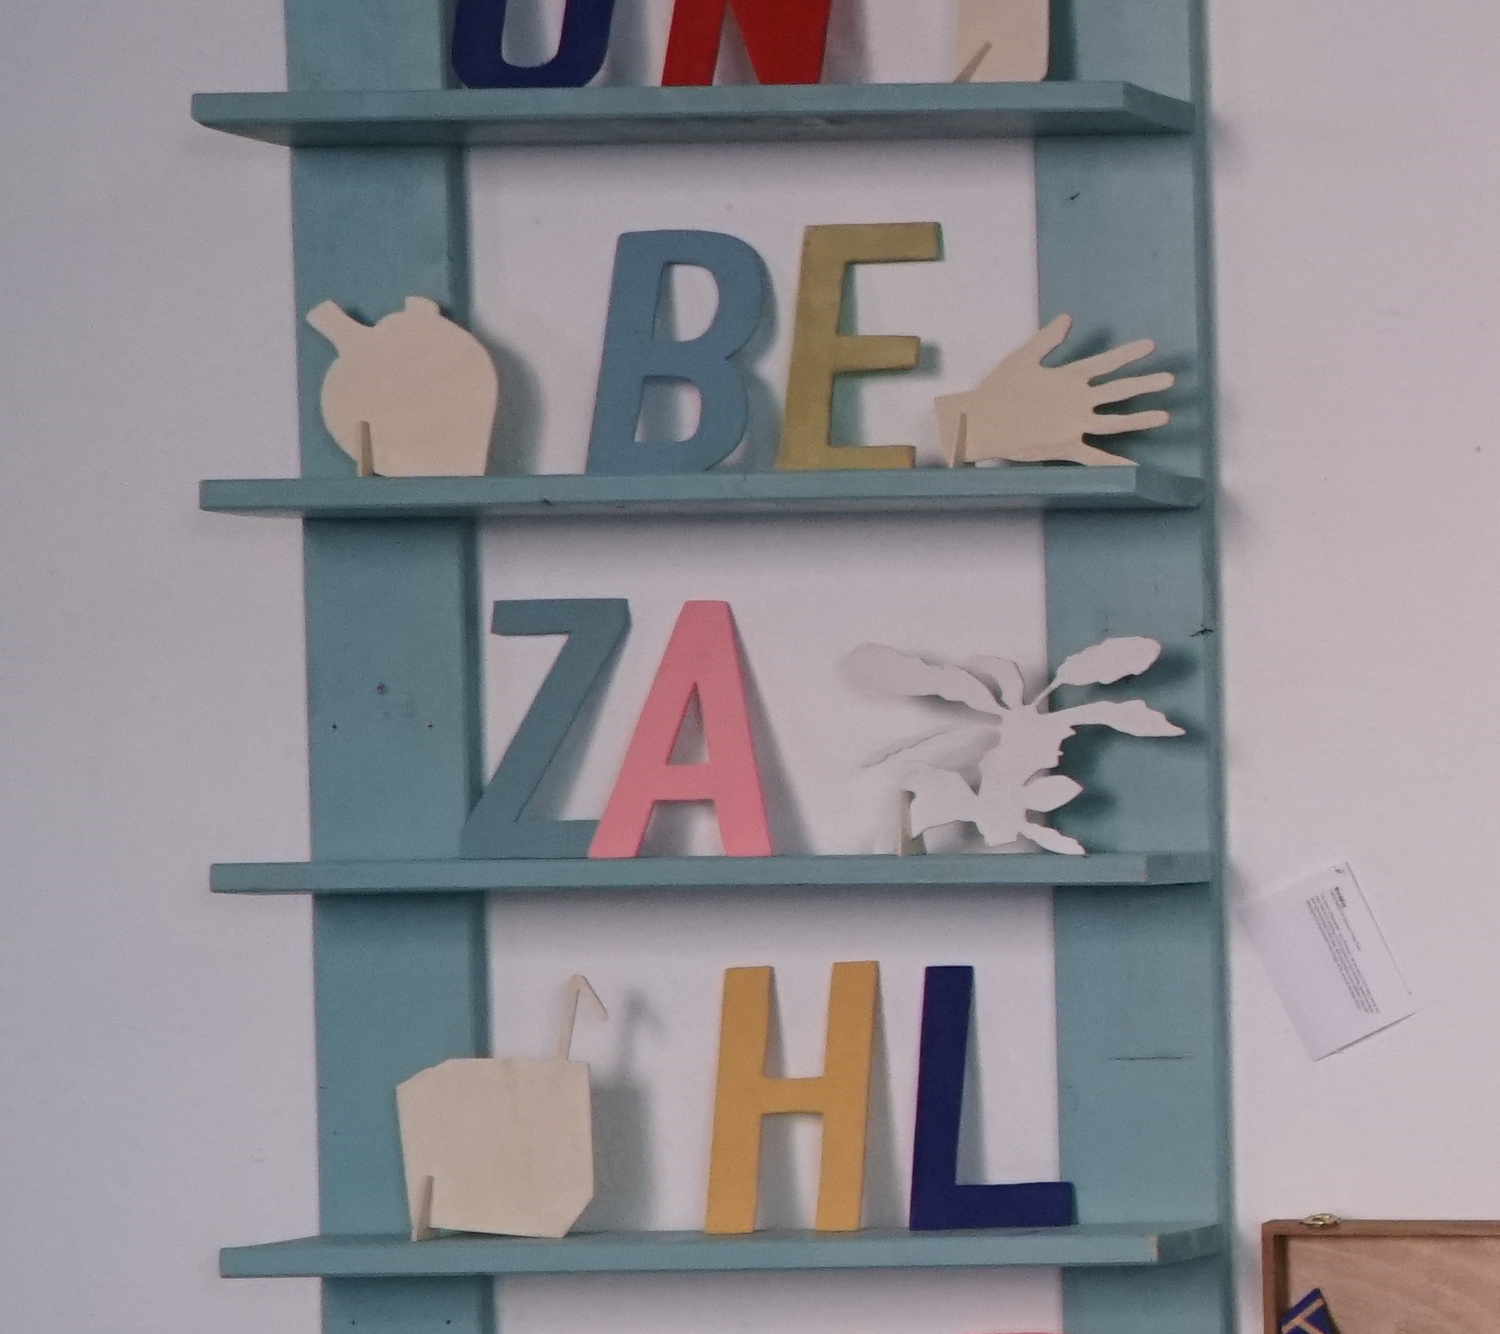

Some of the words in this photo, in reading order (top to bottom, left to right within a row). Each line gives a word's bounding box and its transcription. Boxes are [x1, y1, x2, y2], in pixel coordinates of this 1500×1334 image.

[586, 221, 943, 472] BE
[458, 597, 773, 860] ZA
[704, 961, 1074, 1234] HL
